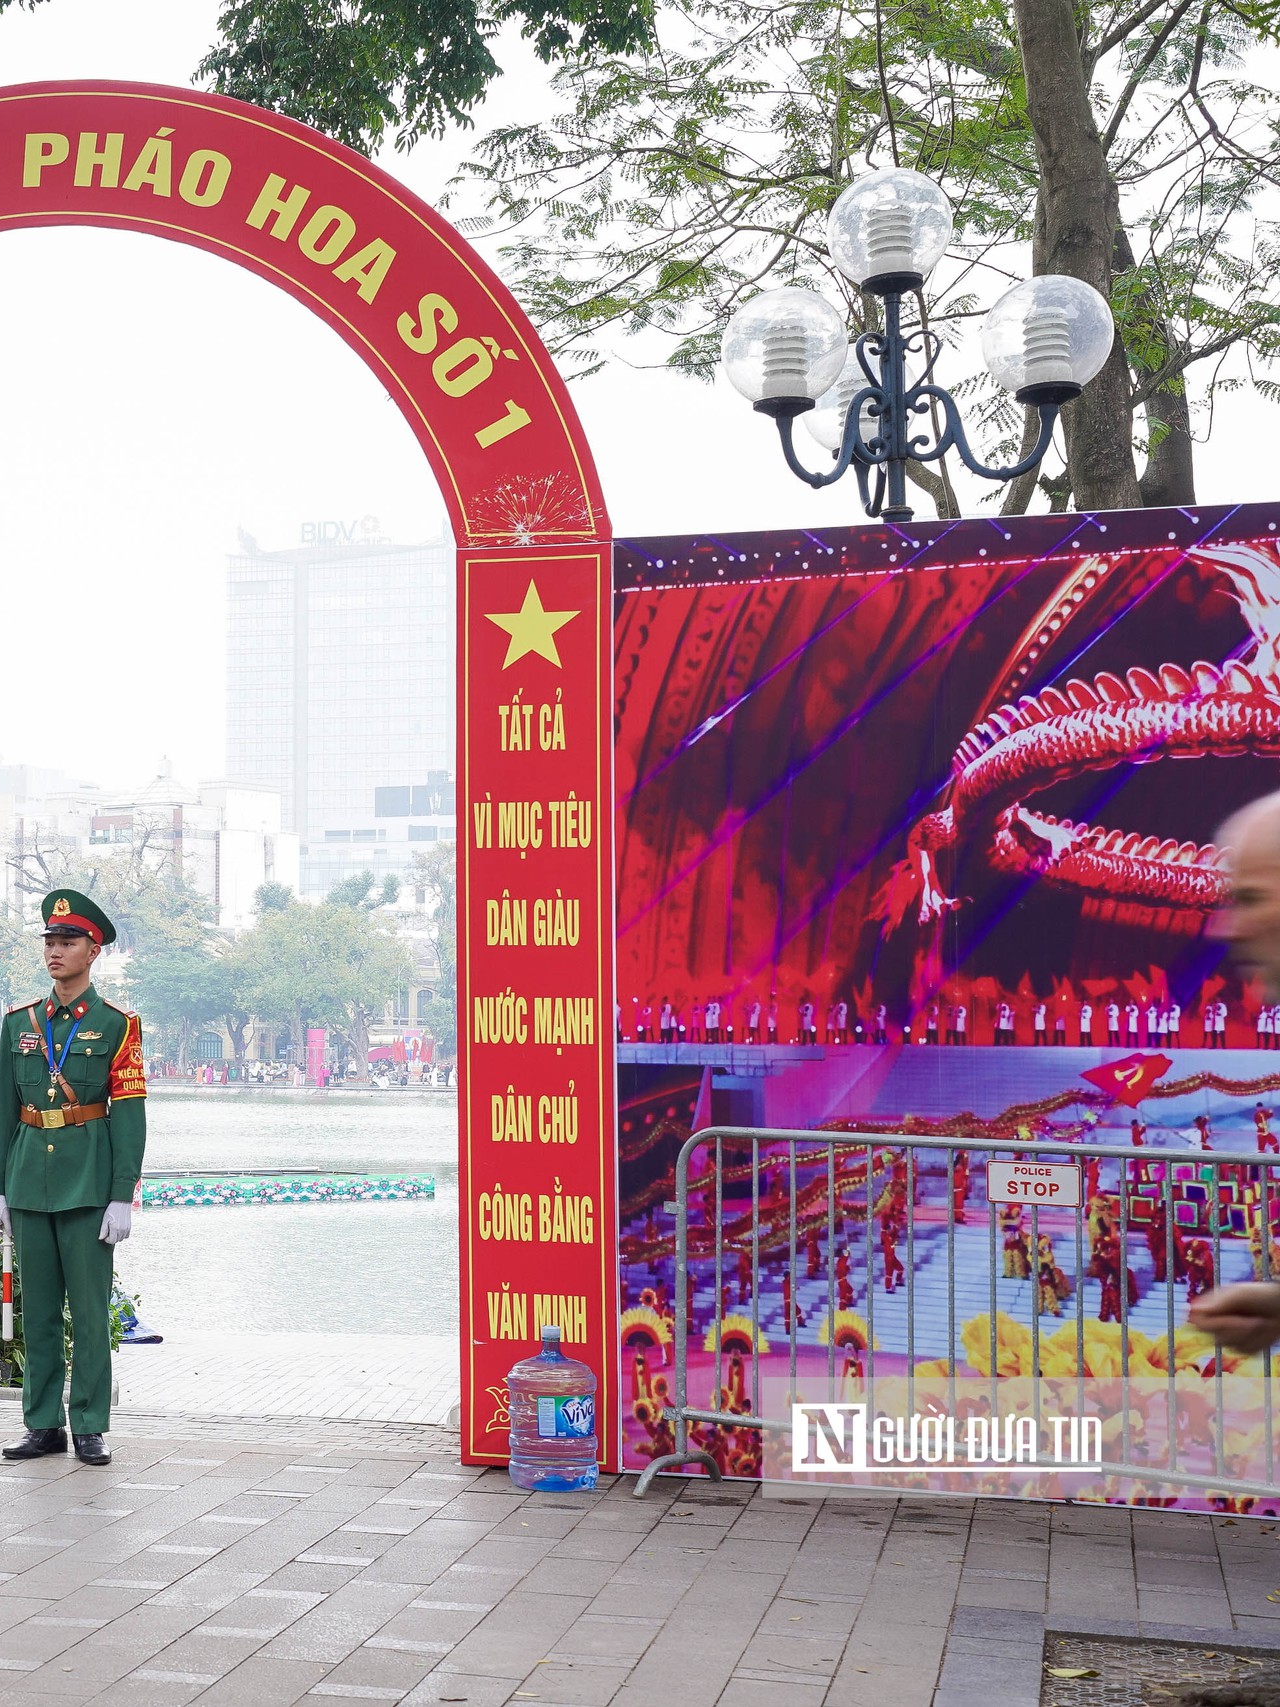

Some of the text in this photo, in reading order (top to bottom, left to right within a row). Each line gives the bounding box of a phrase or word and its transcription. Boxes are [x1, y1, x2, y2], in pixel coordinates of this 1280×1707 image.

[23, 128, 231, 206] PHÁO
[246, 174, 396, 304] HOA
[397, 293, 519, 397] SỐ
[476, 400, 531, 448] 1
[301, 520, 358, 544] BIDV
[499, 686, 565, 751] TẤT CẢ
[474, 790, 591, 859] VÌ MỤC TIÊU
[487, 888, 579, 946] DÂN GIÀU
[475, 986, 593, 1055] NƯỚC MẠNH
[492, 1080, 577, 1143] DÂN CHỦ
[1007, 1180, 1060, 1197] STOP
[1014, 1166, 1052, 1177] POLICE
[479, 1177, 593, 1244] CÔNG BẰNG
[488, 1281, 586, 1343] VĂN MINH
[562, 1402, 593, 1425] Viva
